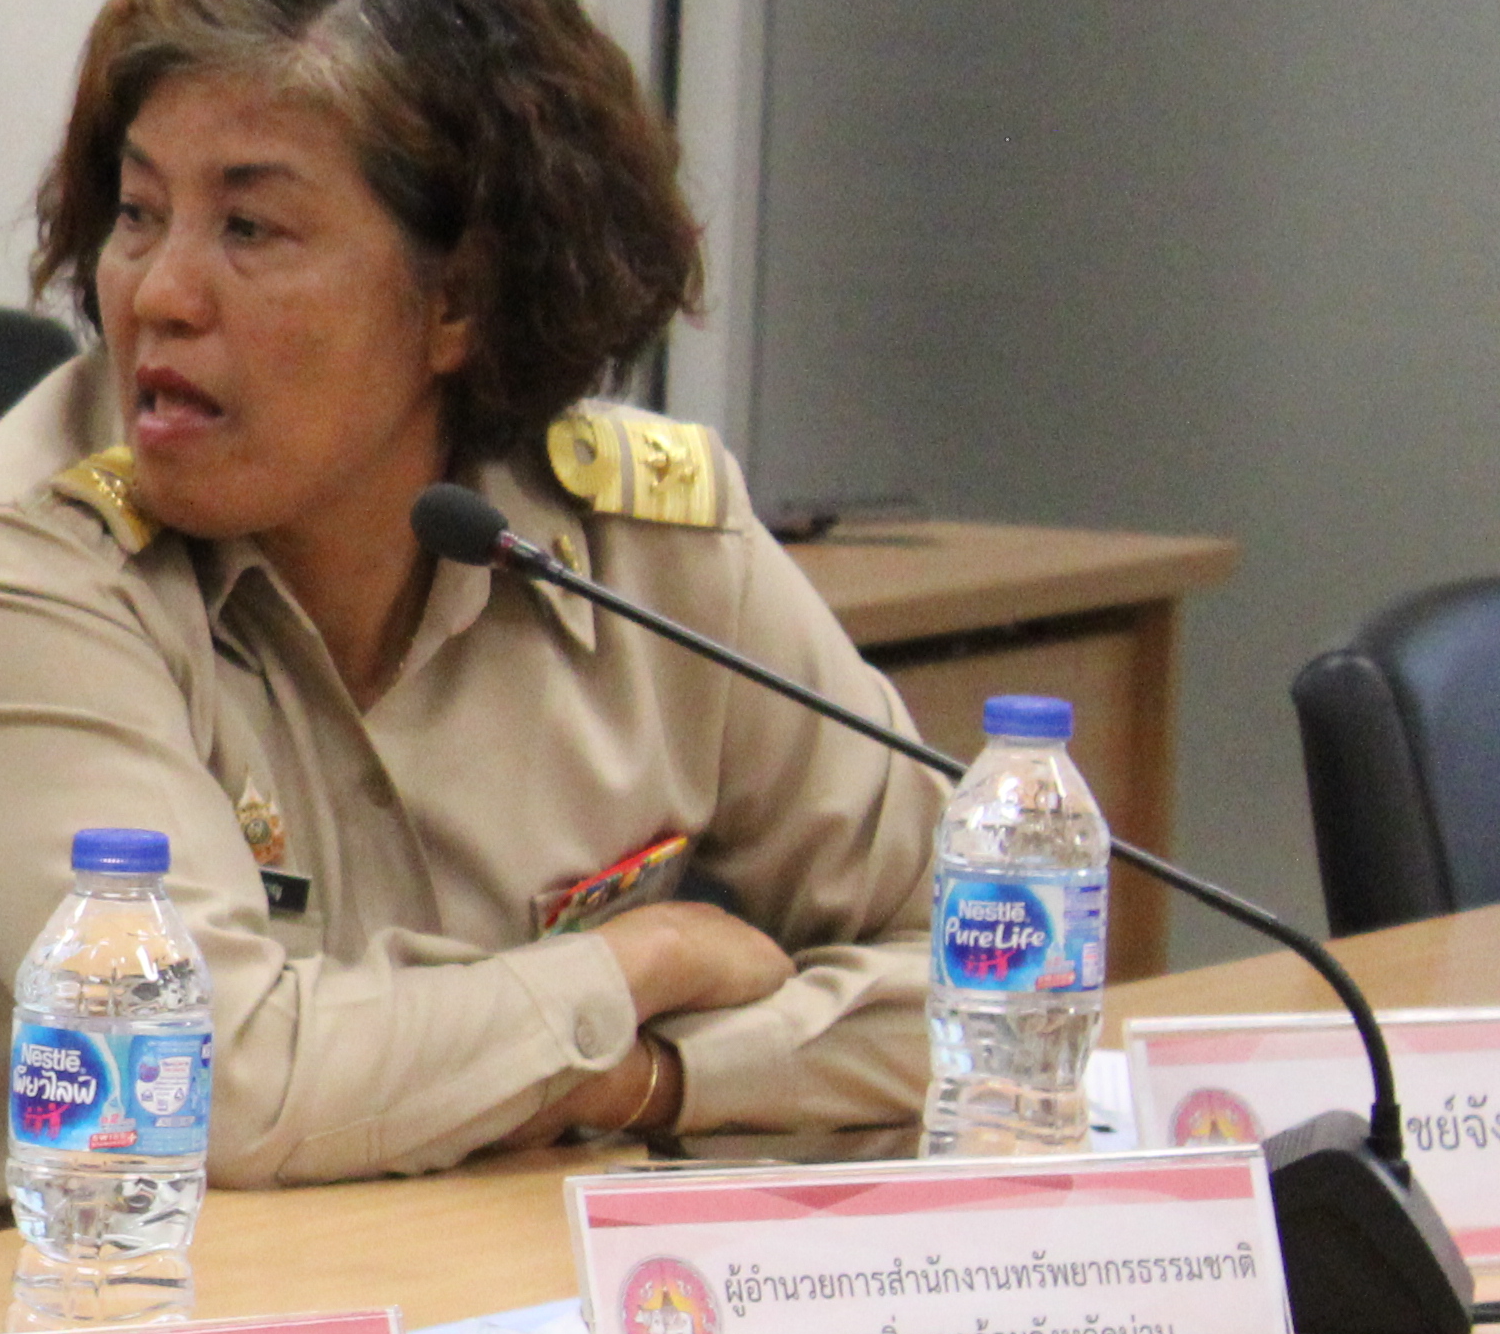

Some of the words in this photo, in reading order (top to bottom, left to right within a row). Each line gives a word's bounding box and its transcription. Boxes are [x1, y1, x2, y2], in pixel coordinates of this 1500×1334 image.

[957, 899, 1028, 923] Nestlé
[21, 1042, 82, 1074] Nestlé
[724, 1240, 1259, 1324] ผู้อำนวยการสำนักงานทรัพยากรธรรมชาติ
